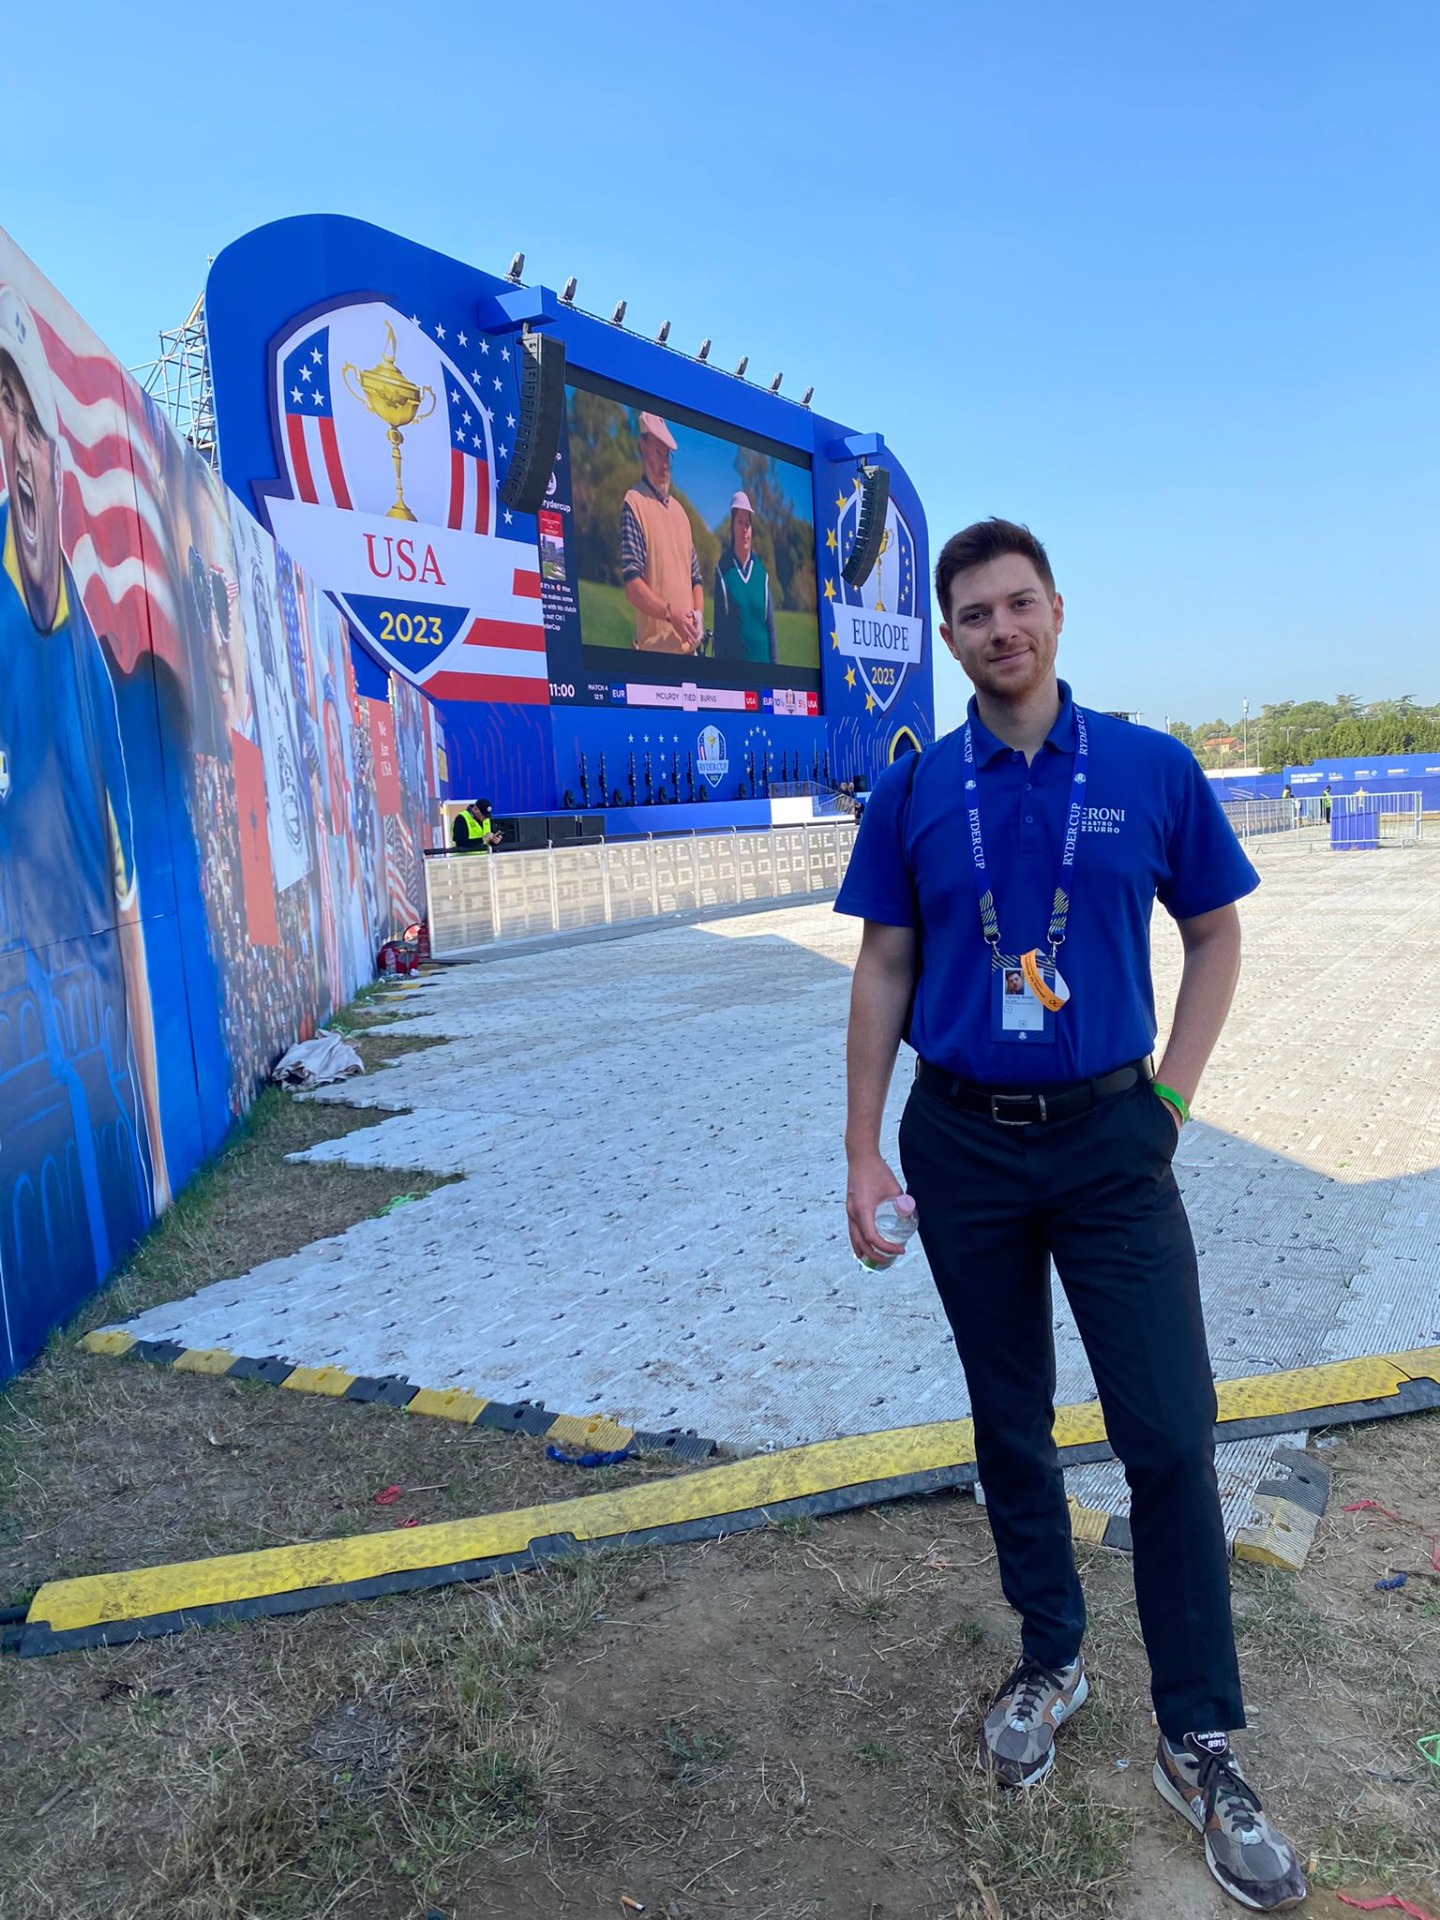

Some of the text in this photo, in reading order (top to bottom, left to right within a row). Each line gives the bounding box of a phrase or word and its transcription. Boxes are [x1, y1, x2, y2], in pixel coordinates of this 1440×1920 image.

[362, 533, 446, 586] USA
[379, 611, 443, 645] 2023
[851, 618, 910, 652] EUROPE
[871, 666, 896, 685] 2023
[549, 683, 575, 698] 11:00
[612, 690, 625, 698] EUR
[656, 692, 717, 702] MCILROY TIED BURNS
[746, 697, 757, 705] USA
[763, 697, 773, 706] EUR
[808, 700, 818, 709] USA
[1078, 723, 1088, 756] RYDER
[964, 743, 973, 763] CUP
[1081, 807, 1126, 822] ERONI
[969, 808, 986, 869] RYDER CUP
[1062, 802, 1081, 866] RYDER CUP
[1081, 825, 1120, 834] ZZURRO
